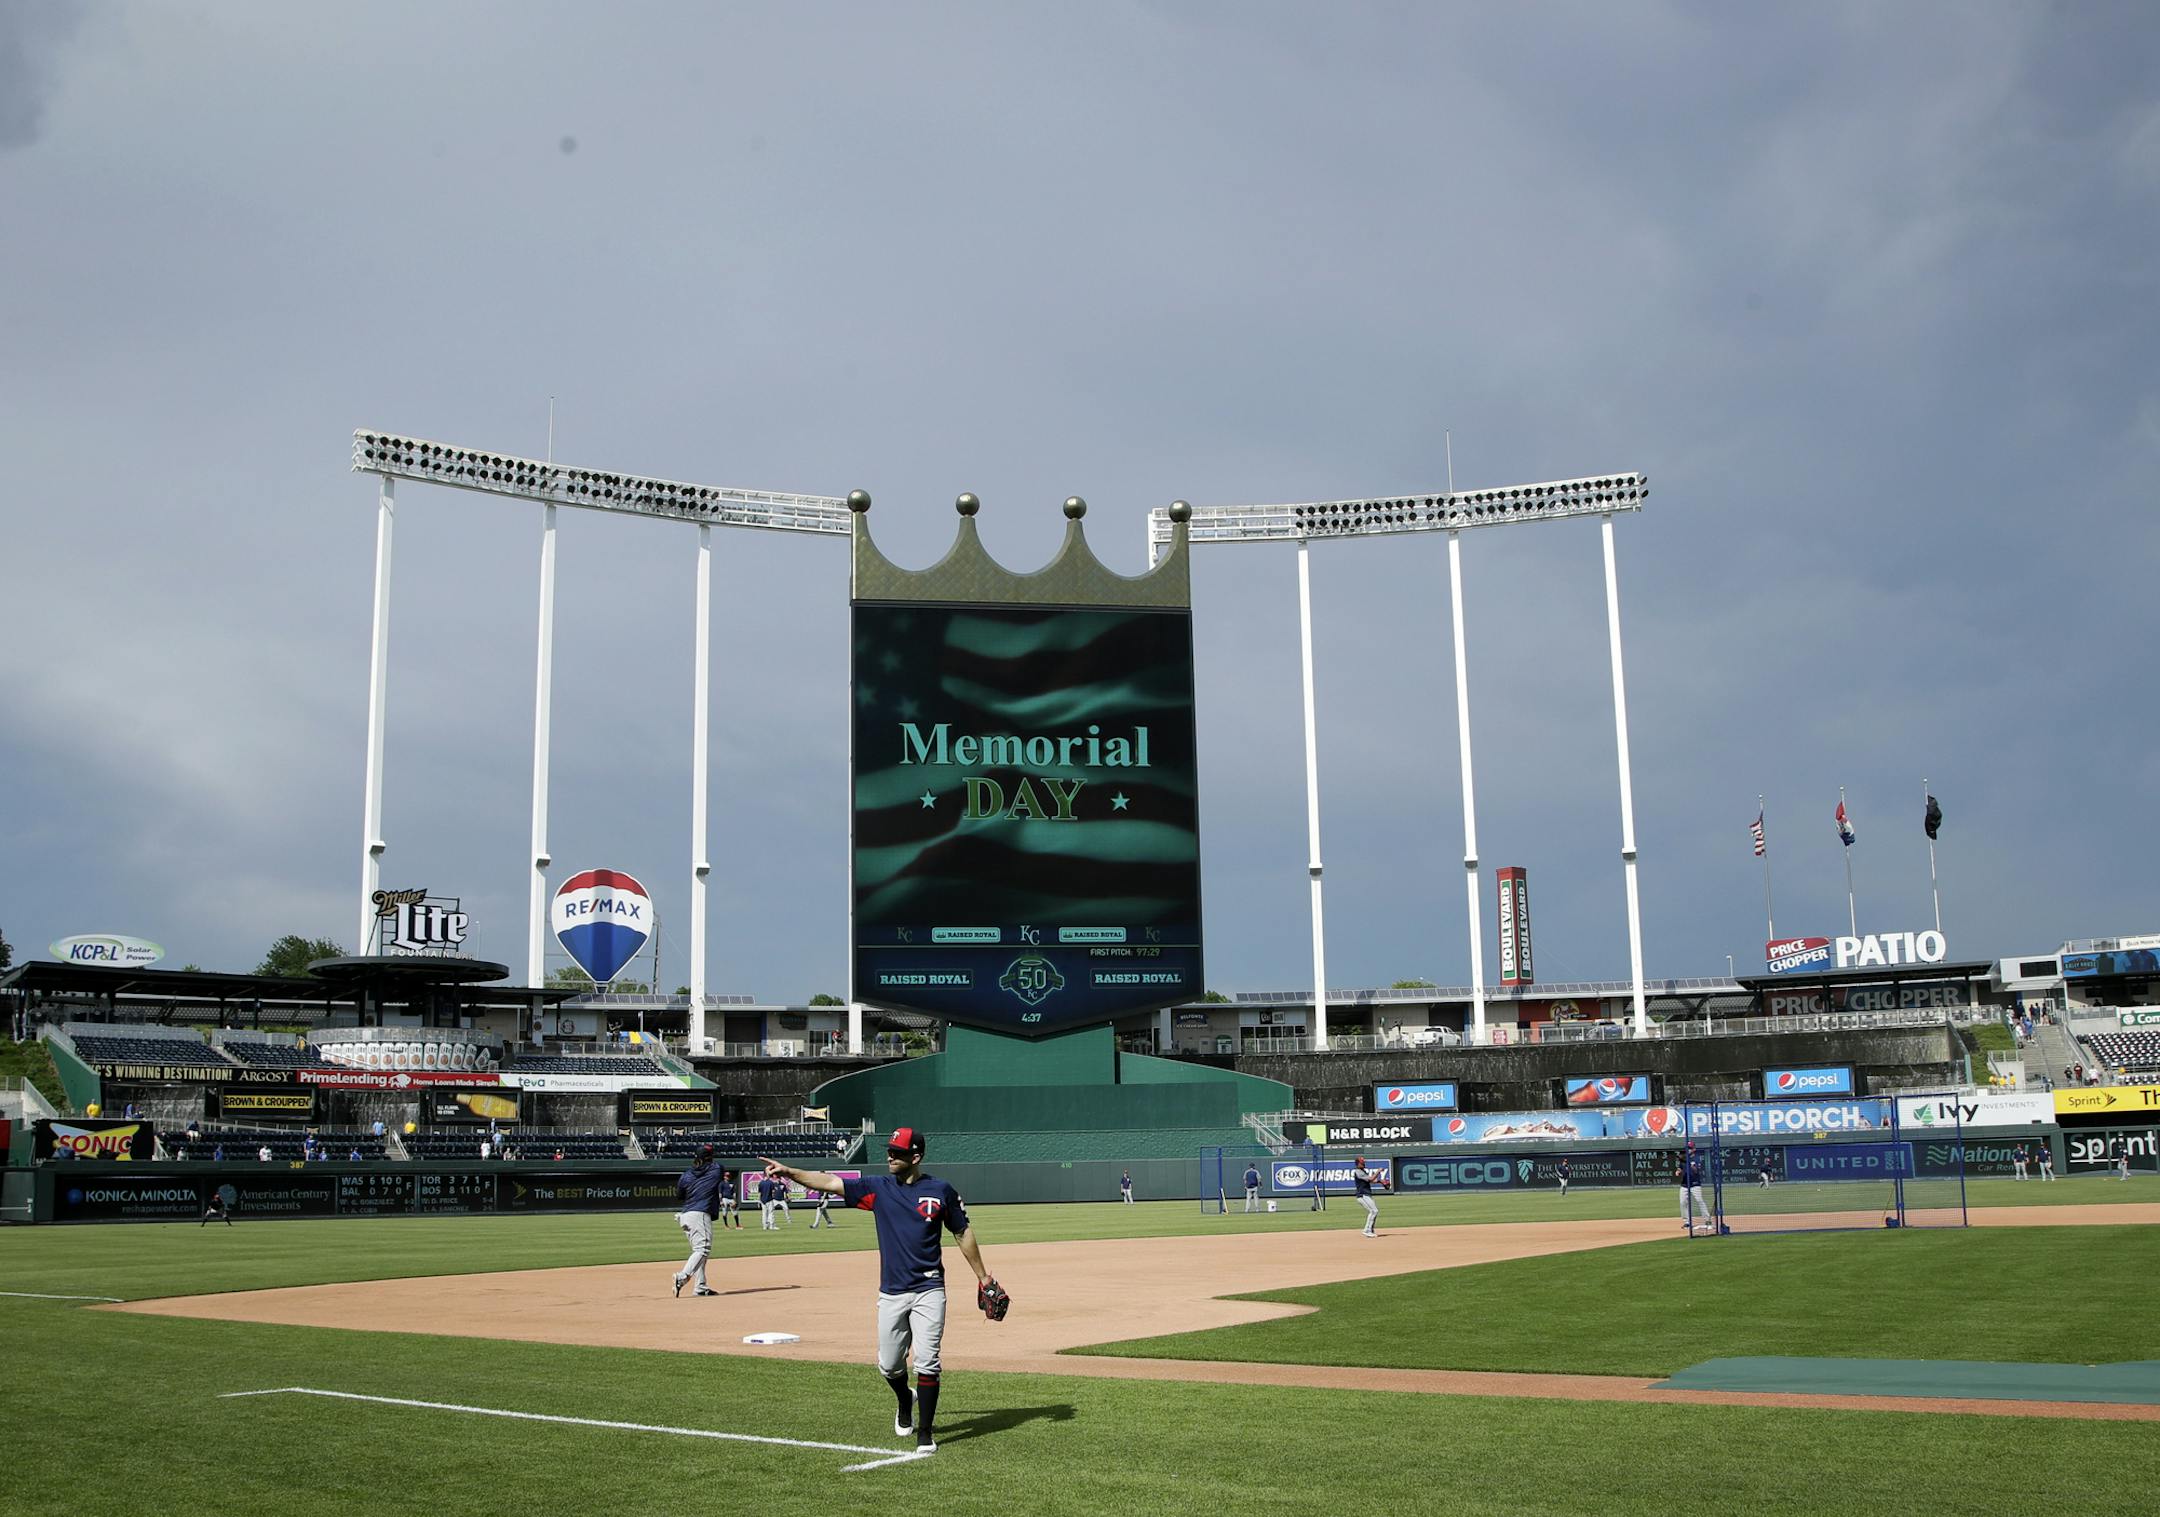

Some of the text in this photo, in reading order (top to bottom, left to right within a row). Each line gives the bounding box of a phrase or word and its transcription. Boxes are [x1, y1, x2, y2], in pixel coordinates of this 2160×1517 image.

[899, 722, 1152, 767] Memorial
[962, 776, 1088, 822] DAY
[372, 888, 428, 916] Miller
[566, 898, 641, 920] RE/MAX
[392, 902, 469, 950] Lite
[1501, 886, 1514, 972] BOULEVARD
[1518, 886, 1531, 971] BOULEVARD
[896, 926, 913, 943] KC
[947, 931, 998, 939] RAISED ROYAL
[1019, 924, 1040, 946] KC
[1074, 931, 1122, 939] RAISED ROYAL
[1144, 926, 1161, 943] KC
[70, 944, 119, 961] KCP&L
[390, 949, 450, 958] FOUNTAIN
[1090, 948, 1109, 956] FIRST
[1769, 939, 1807, 958] PRICE
[1835, 930, 1946, 968] PATIO
[1769, 949, 1829, 973] CHOPPER
[880, 974, 970, 985] RAISED ROYAL
[1018, 968, 1047, 990] 50
[1094, 973, 1182, 985] RAISED ROYAL
[1850, 987, 1960, 1011] CHOPPER
[1021, 1013, 1042, 1022] 4:37
[115, 1065, 161, 1079] WINNING
[163, 1067, 232, 1081] DESTINATION!
[238, 1071, 289, 1082] ARGOSY
[300, 1071, 388, 1087] PrimeLending
[412, 1078, 433, 1086] Home
[475, 1079, 498, 1087] Simple
[518, 1076, 545, 1087] teva
[1798, 1074, 1838, 1088] pepsi
[656, 1081, 672, 1089] days
[224, 1096, 309, 1107] BROWN & CROUPPEN
[1407, 1089, 1444, 1104] pepsi
[2068, 1096, 2101, 1107] Sprint
[2140, 1089, 2160, 1106] Th
[633, 1102, 708, 1111] BROWN & CROUPPEN
[1981, 1101, 2036, 1109] INVESTMENTS
[1939, 1102, 1979, 1122] Ivy
[1692, 1106, 1860, 1133] PEPSI PORCH
[1330, 1127, 1411, 1140] H&R BLOCK
[58, 1134, 133, 1154] SONIC
[1635, 1152, 1658, 1160] NYM
[1662, 1151, 1667, 1160] 3
[1738, 1149, 1744, 1157] 7
[1749, 1149, 1760, 1157] 12
[1763, 1148, 1770, 1156] 0
[1774, 1153, 1780, 1161] F
[290, 1161, 305, 1169] 387
[1635, 1160, 1652, 1169] ATL
[1662, 1160, 1669, 1168] 4
[1738, 1158, 1745, 1166] 0
[1796, 1156, 1879, 1170] UNITED
[1537, 1164, 1552, 1172] THE
[1977, 1164, 1993, 1172] Car
[1282, 1170, 1301, 1179] FOX
[1402, 1162, 1511, 1186] GEICO
[1569, 1170, 1599, 1179] HEALTH
[1600, 1169, 1629, 1178] SYSTEM
[341, 1176, 402, 1185] WAS 6 10 0
[422, 1176, 480, 1184] TOR 3 7 1
[485, 1181, 490, 1189] F
[341, 1187, 402, 1196] BAL 0 7 0
[406, 1182, 412, 1190] F
[422, 1186, 481, 1195] BOS 8 11 0
[85, 1189, 197, 1202] KONICA MINOLTA
[240, 1188, 331, 1201] American Century
[534, 1186, 678, 1199] The BEST Price for Unlimit
[122, 1204, 198, 1214] reshapework.com
[240, 1200, 301, 1211] Investments
[918, 1196, 941, 1222] T
